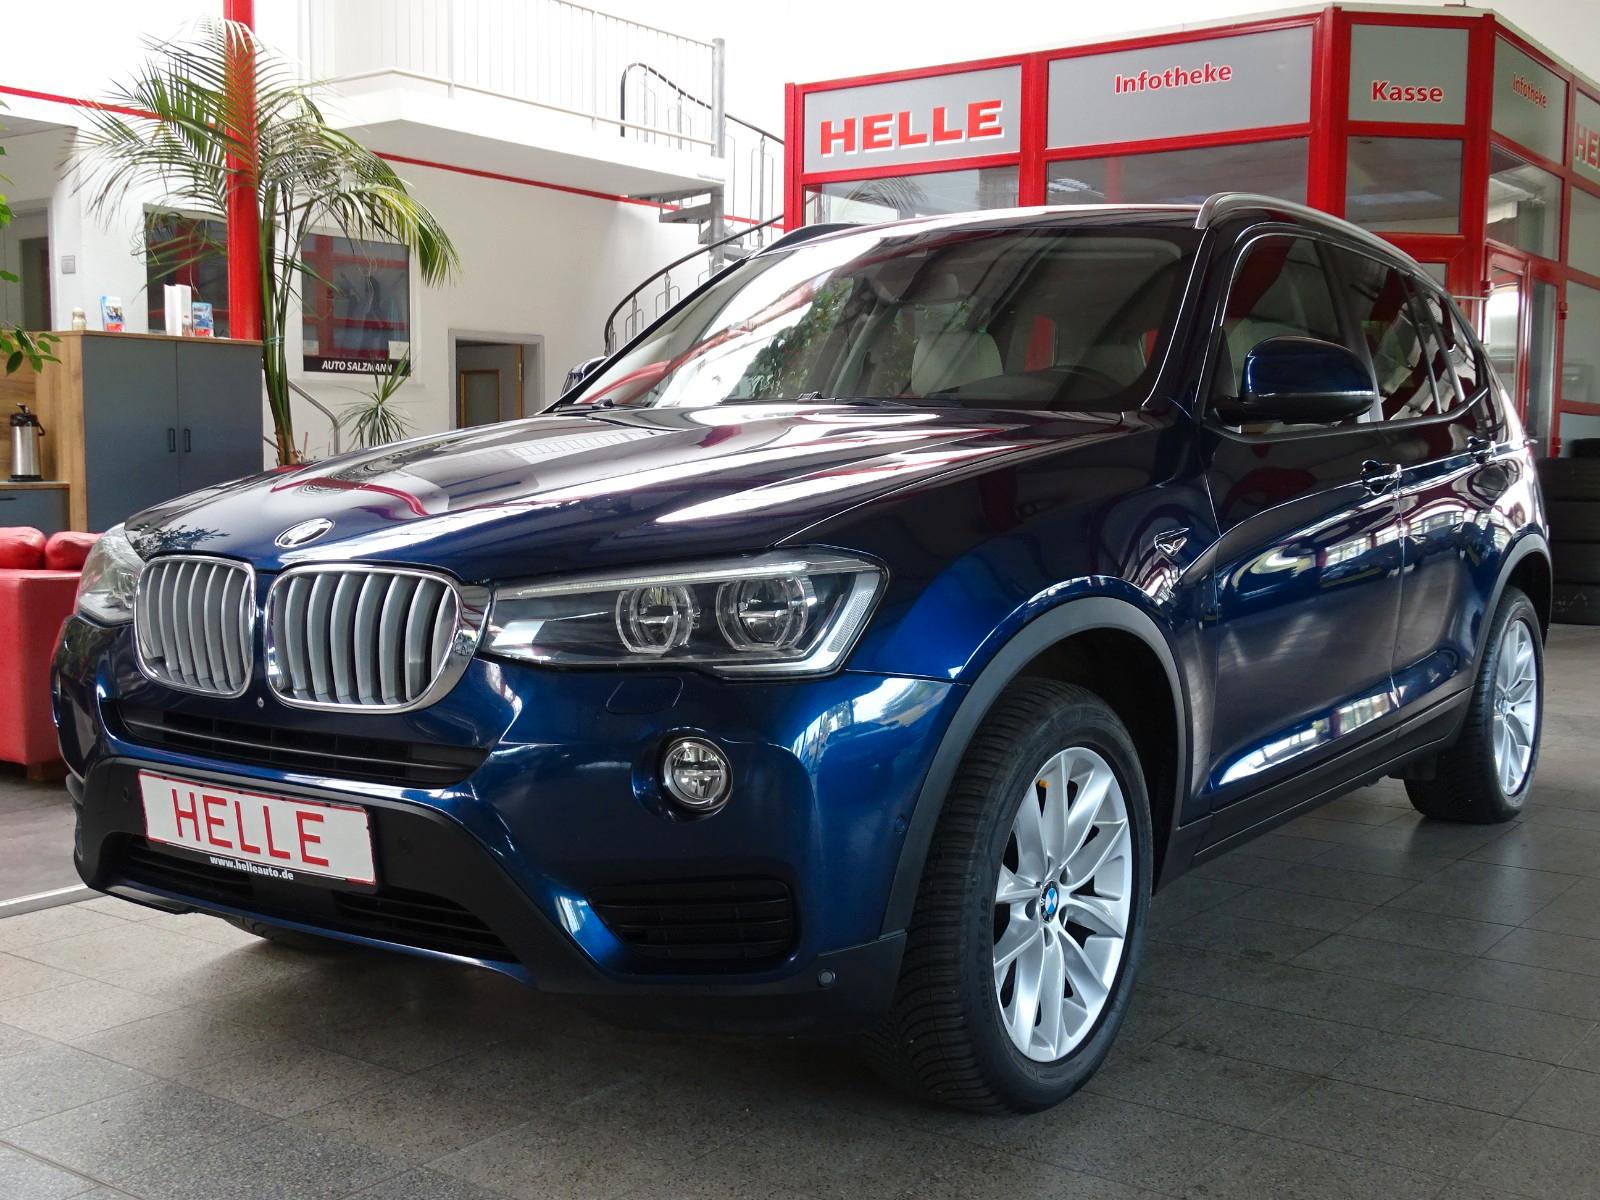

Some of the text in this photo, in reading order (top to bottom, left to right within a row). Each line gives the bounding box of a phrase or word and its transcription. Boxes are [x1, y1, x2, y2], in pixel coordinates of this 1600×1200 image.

[1115, 62, 1232, 94] Infotheke
[1371, 80, 1444, 104] Kasse
[1512, 72, 1547, 109] Infotheke
[820, 99, 1005, 158] HELLE
[321, 360, 346, 370] AUTO
[171, 788, 329, 867] HELLE
[209, 856, 294, 881] www.helleauto.de
